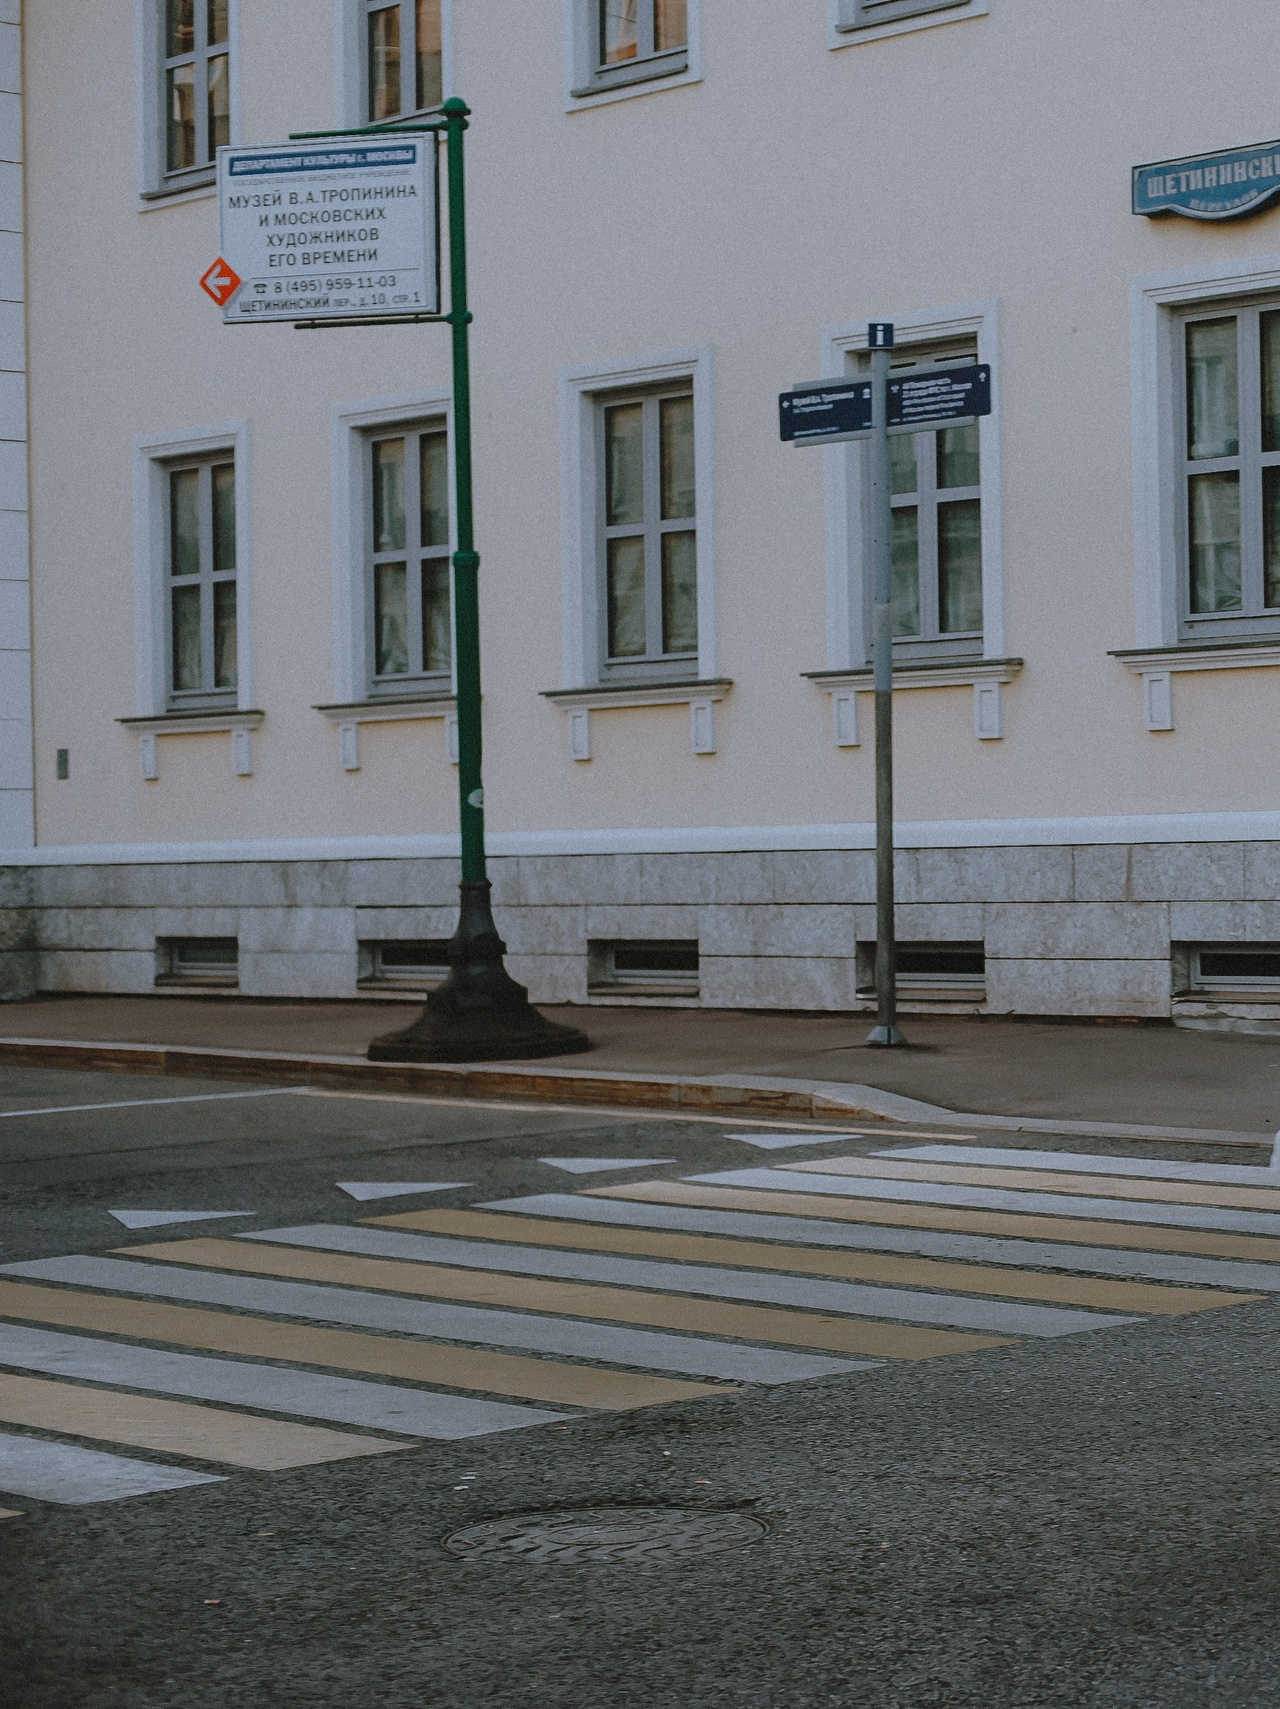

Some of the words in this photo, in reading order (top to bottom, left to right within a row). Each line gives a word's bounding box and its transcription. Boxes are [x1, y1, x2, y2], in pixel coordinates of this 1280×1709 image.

[229, 189, 282, 209] МУЗЕЙ
[259, 213, 269, 227] И
[274, 206, 386, 226] МОСКОВСКИХ
[266, 227, 380, 248] ХУДОЖНИКОВ
[269, 253, 296, 268] ЕГО
[301, 248, 378, 266] ВРЕМЕНИ
[274, 281, 282, 294] 8
[286, 279, 322, 295] (495)
[325, 275, 396, 291] 959-11-03
[240, 293, 330, 314] ЩЕТИНИНСКИЙ
[413, 291, 420, 303] 1
